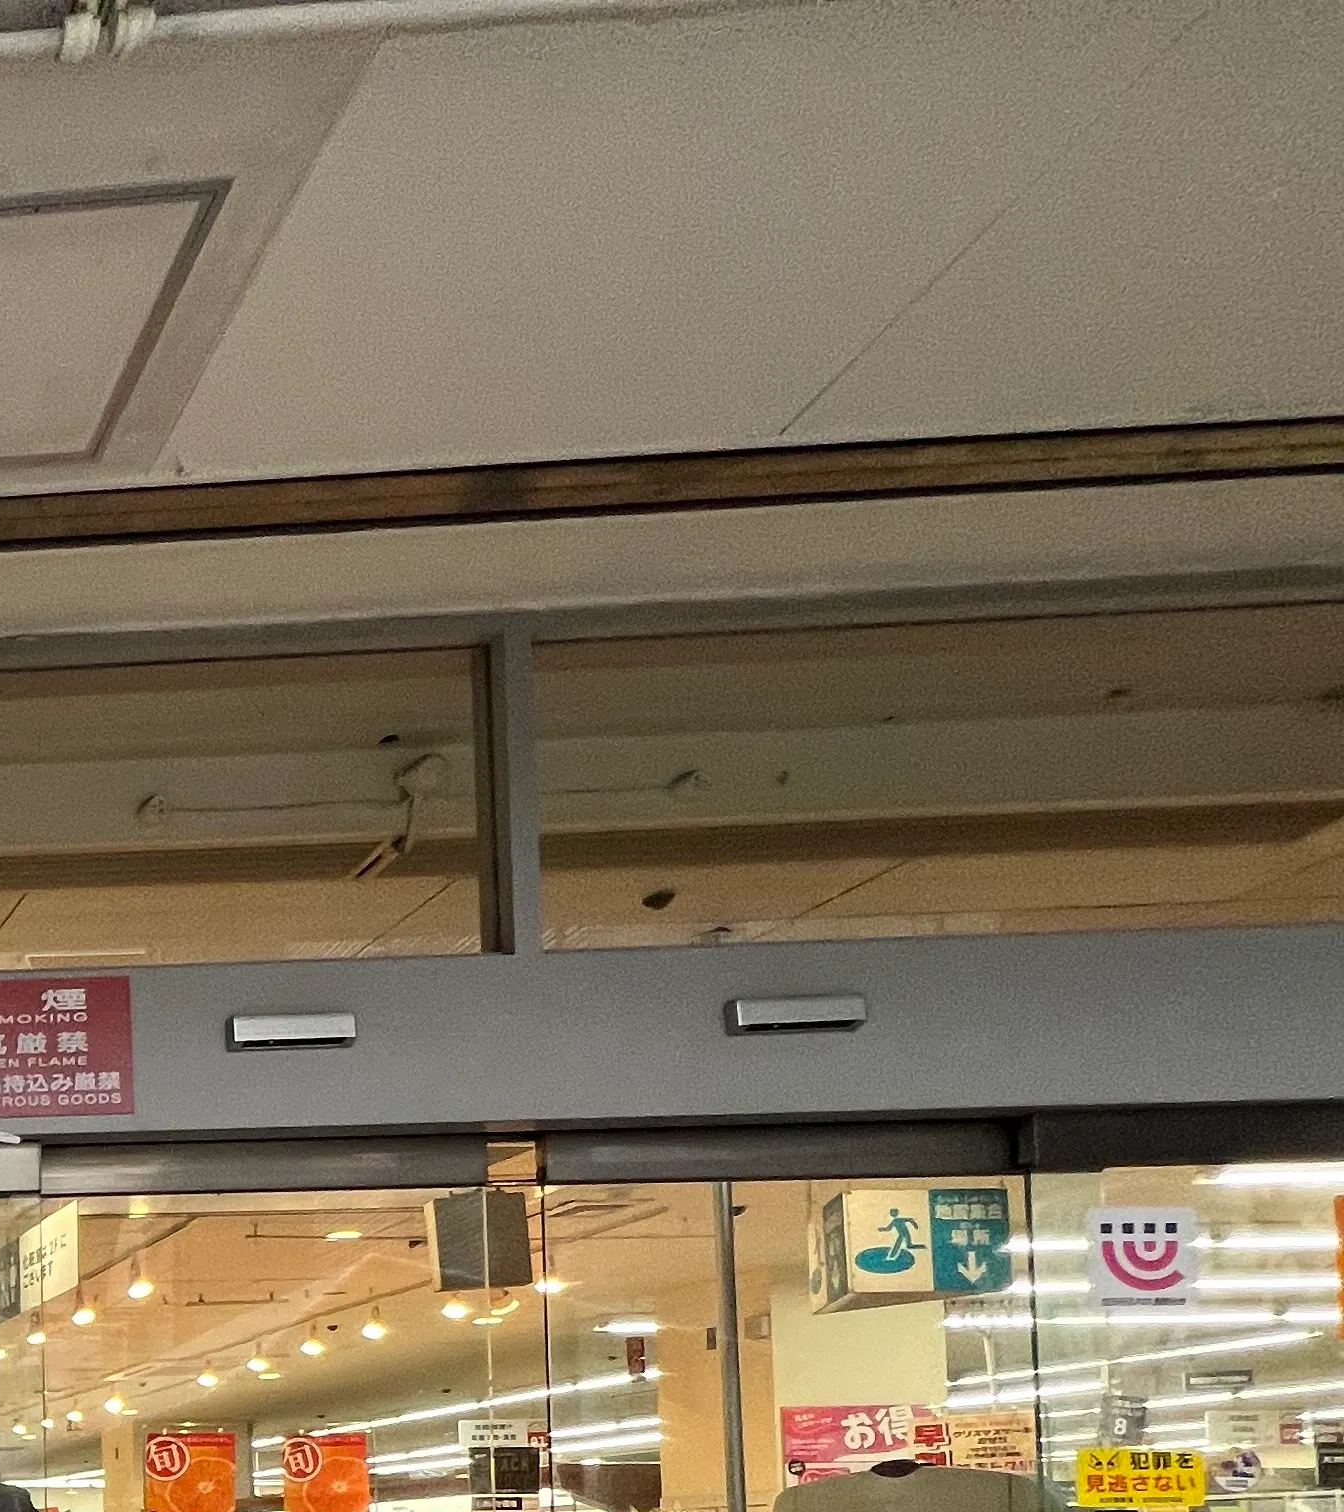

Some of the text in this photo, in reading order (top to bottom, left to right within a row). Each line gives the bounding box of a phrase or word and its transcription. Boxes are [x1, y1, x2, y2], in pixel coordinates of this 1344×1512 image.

[25, 1055, 88, 1068] FLAME
[57, 1092, 122, 1107] GOODS
[1114, 1418, 1127, 1435] 8
[148, 1439, 181, 1473] 旬
[283, 1440, 314, 1474] 旬
[1130, 1451, 1194, 1471] 犯罪を
[1086, 1474, 1196, 1493] 見逃さない
